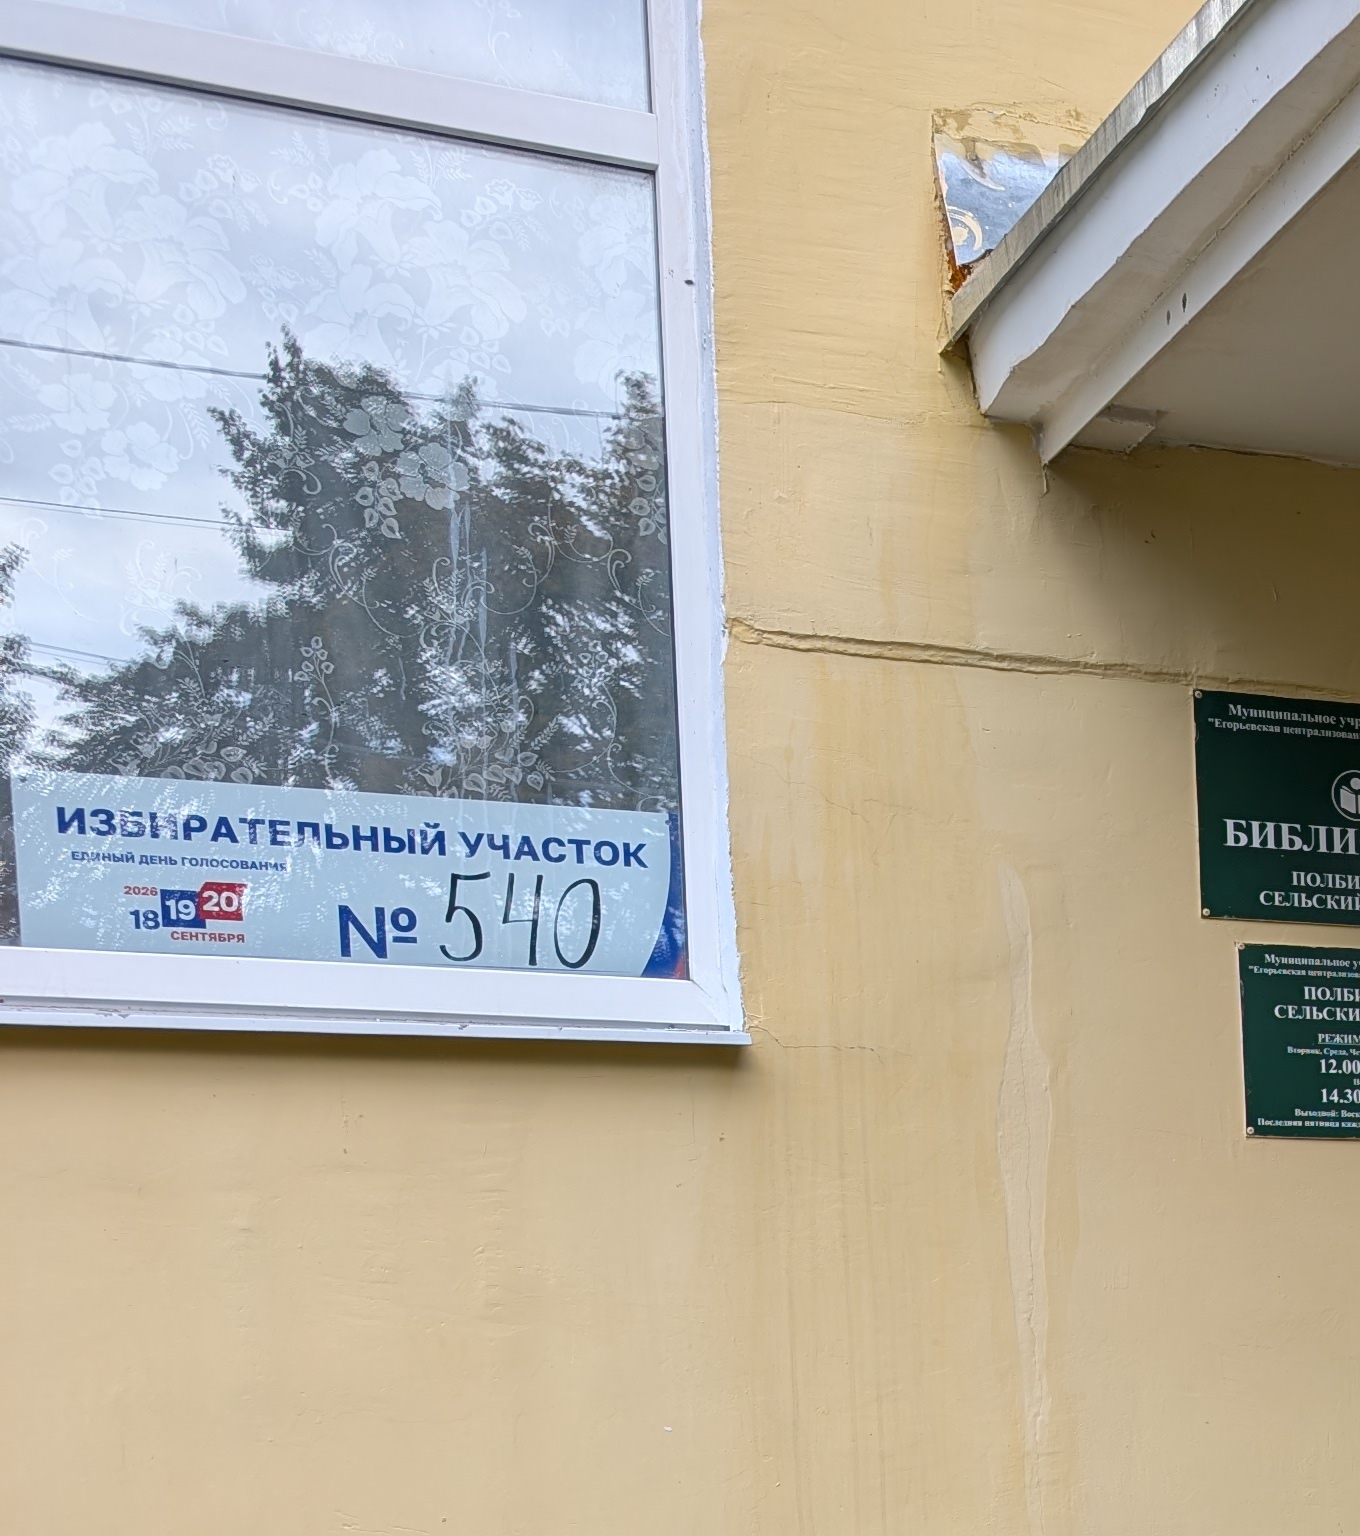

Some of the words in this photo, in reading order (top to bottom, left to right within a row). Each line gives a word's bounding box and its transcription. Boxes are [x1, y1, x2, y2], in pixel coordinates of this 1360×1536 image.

[1228, 704, 1336, 724] Муниципальное
[56, 806, 447, 857] ИЗБИРАТЕЛЬНЫЙ
[457, 831, 649, 869] УЧАСТОК
[71, 851, 135, 864] ЕДИНЫЙ
[139, 854, 178, 867] ДЕНЬ
[181, 857, 288, 872] ГОЛОСОВАНИЯ
[123, 885, 158, 896] 2026
[129, 909, 160, 930] 18
[165, 899, 195, 921] 19
[202, 891, 239, 912] 20
[337, 905, 418, 960] №
[439, 871, 601, 969] 540
[170, 930, 245, 944] СЕНТЯБРЯ
[1264, 953, 1350, 967] Муниципальное
[1320, 1059, 1360, 1074] 12.00
